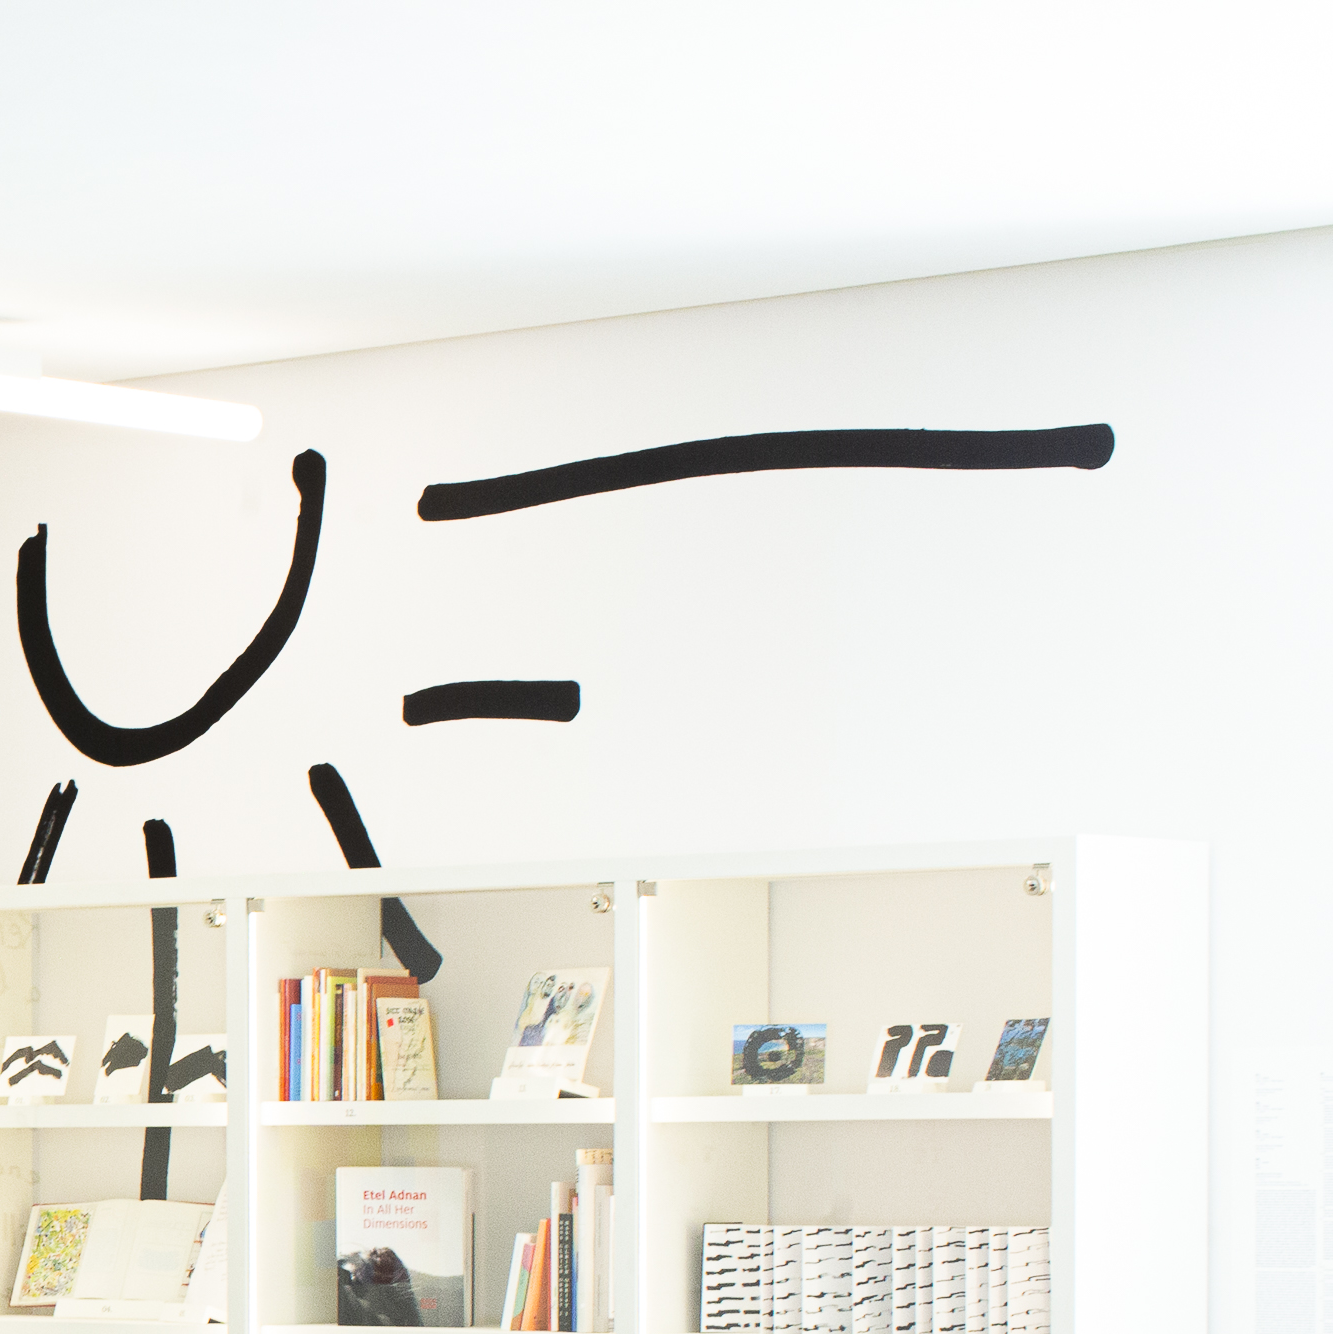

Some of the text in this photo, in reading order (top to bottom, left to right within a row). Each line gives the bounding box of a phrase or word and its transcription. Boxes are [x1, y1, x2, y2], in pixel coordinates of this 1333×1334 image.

[363, 1190, 427, 1200] Etel Adnan
[363, 1204, 415, 1214] In All Her
[363, 1218, 428, 1229] Dimensions
